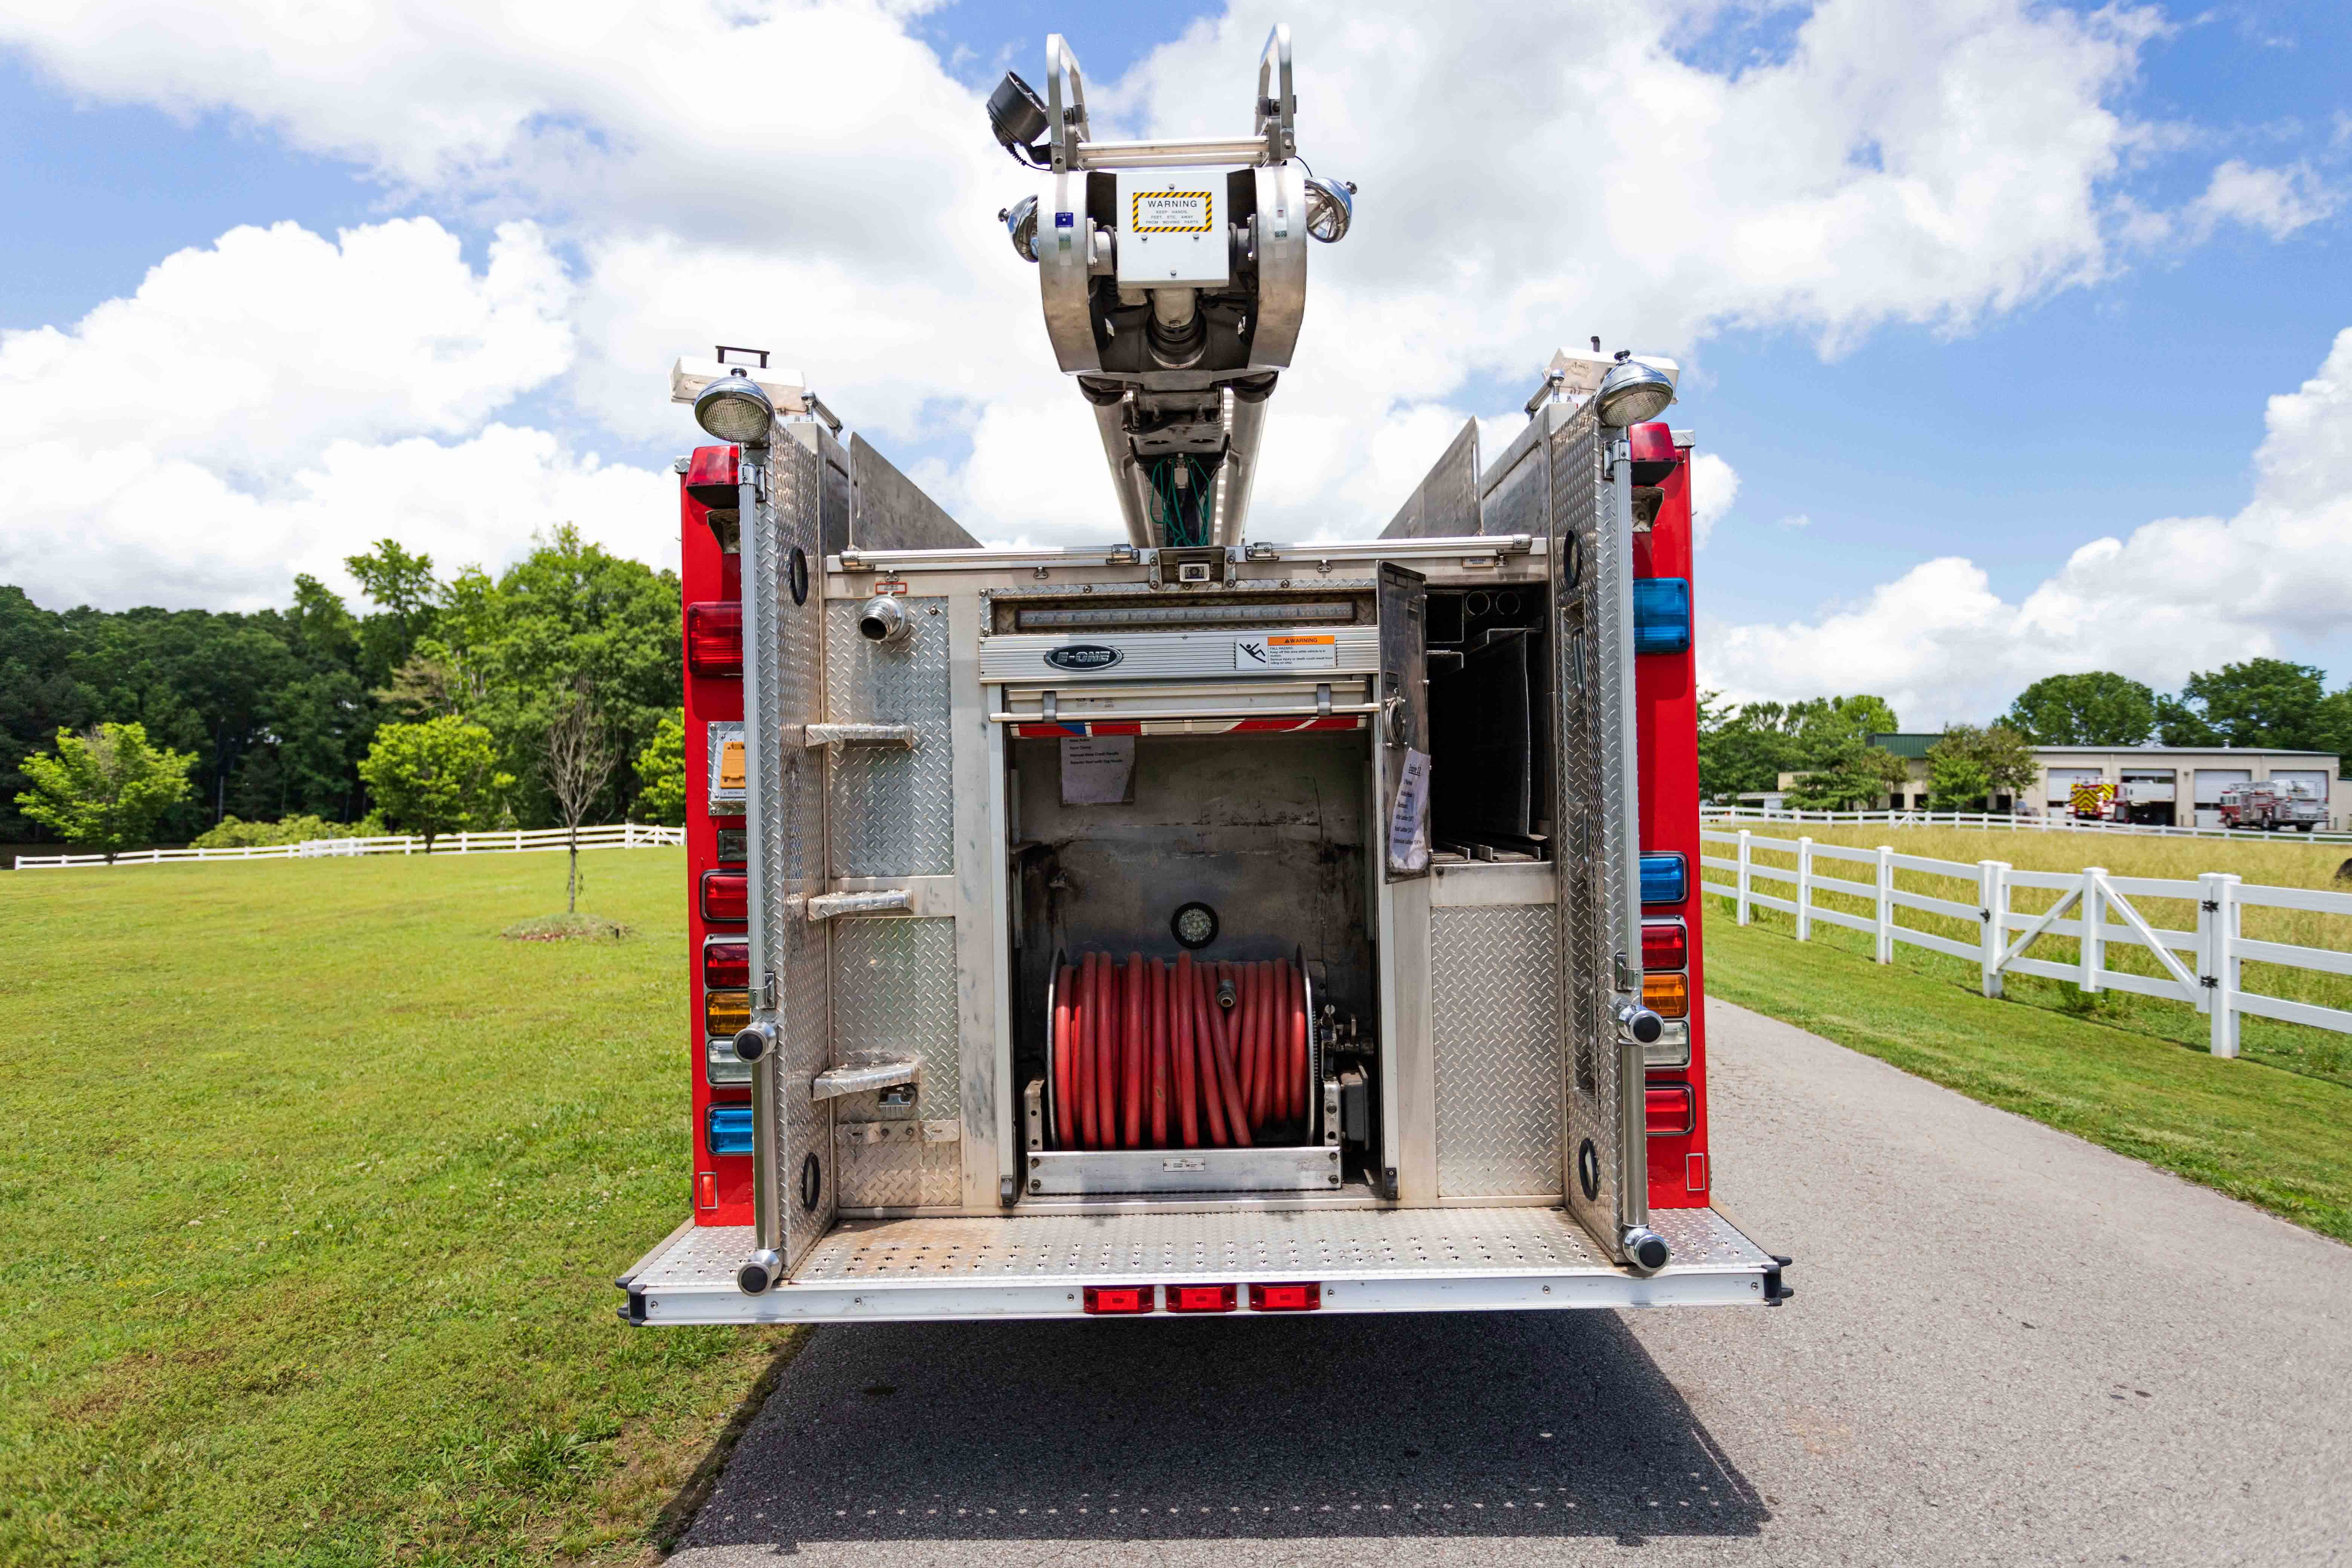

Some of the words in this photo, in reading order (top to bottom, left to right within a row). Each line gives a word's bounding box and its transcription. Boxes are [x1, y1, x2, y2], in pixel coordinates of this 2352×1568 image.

[1057, 651, 1110, 663] E-ONE
[1409, 764, 1417, 773] Engine
[1417, 766, 1421, 774] 12
